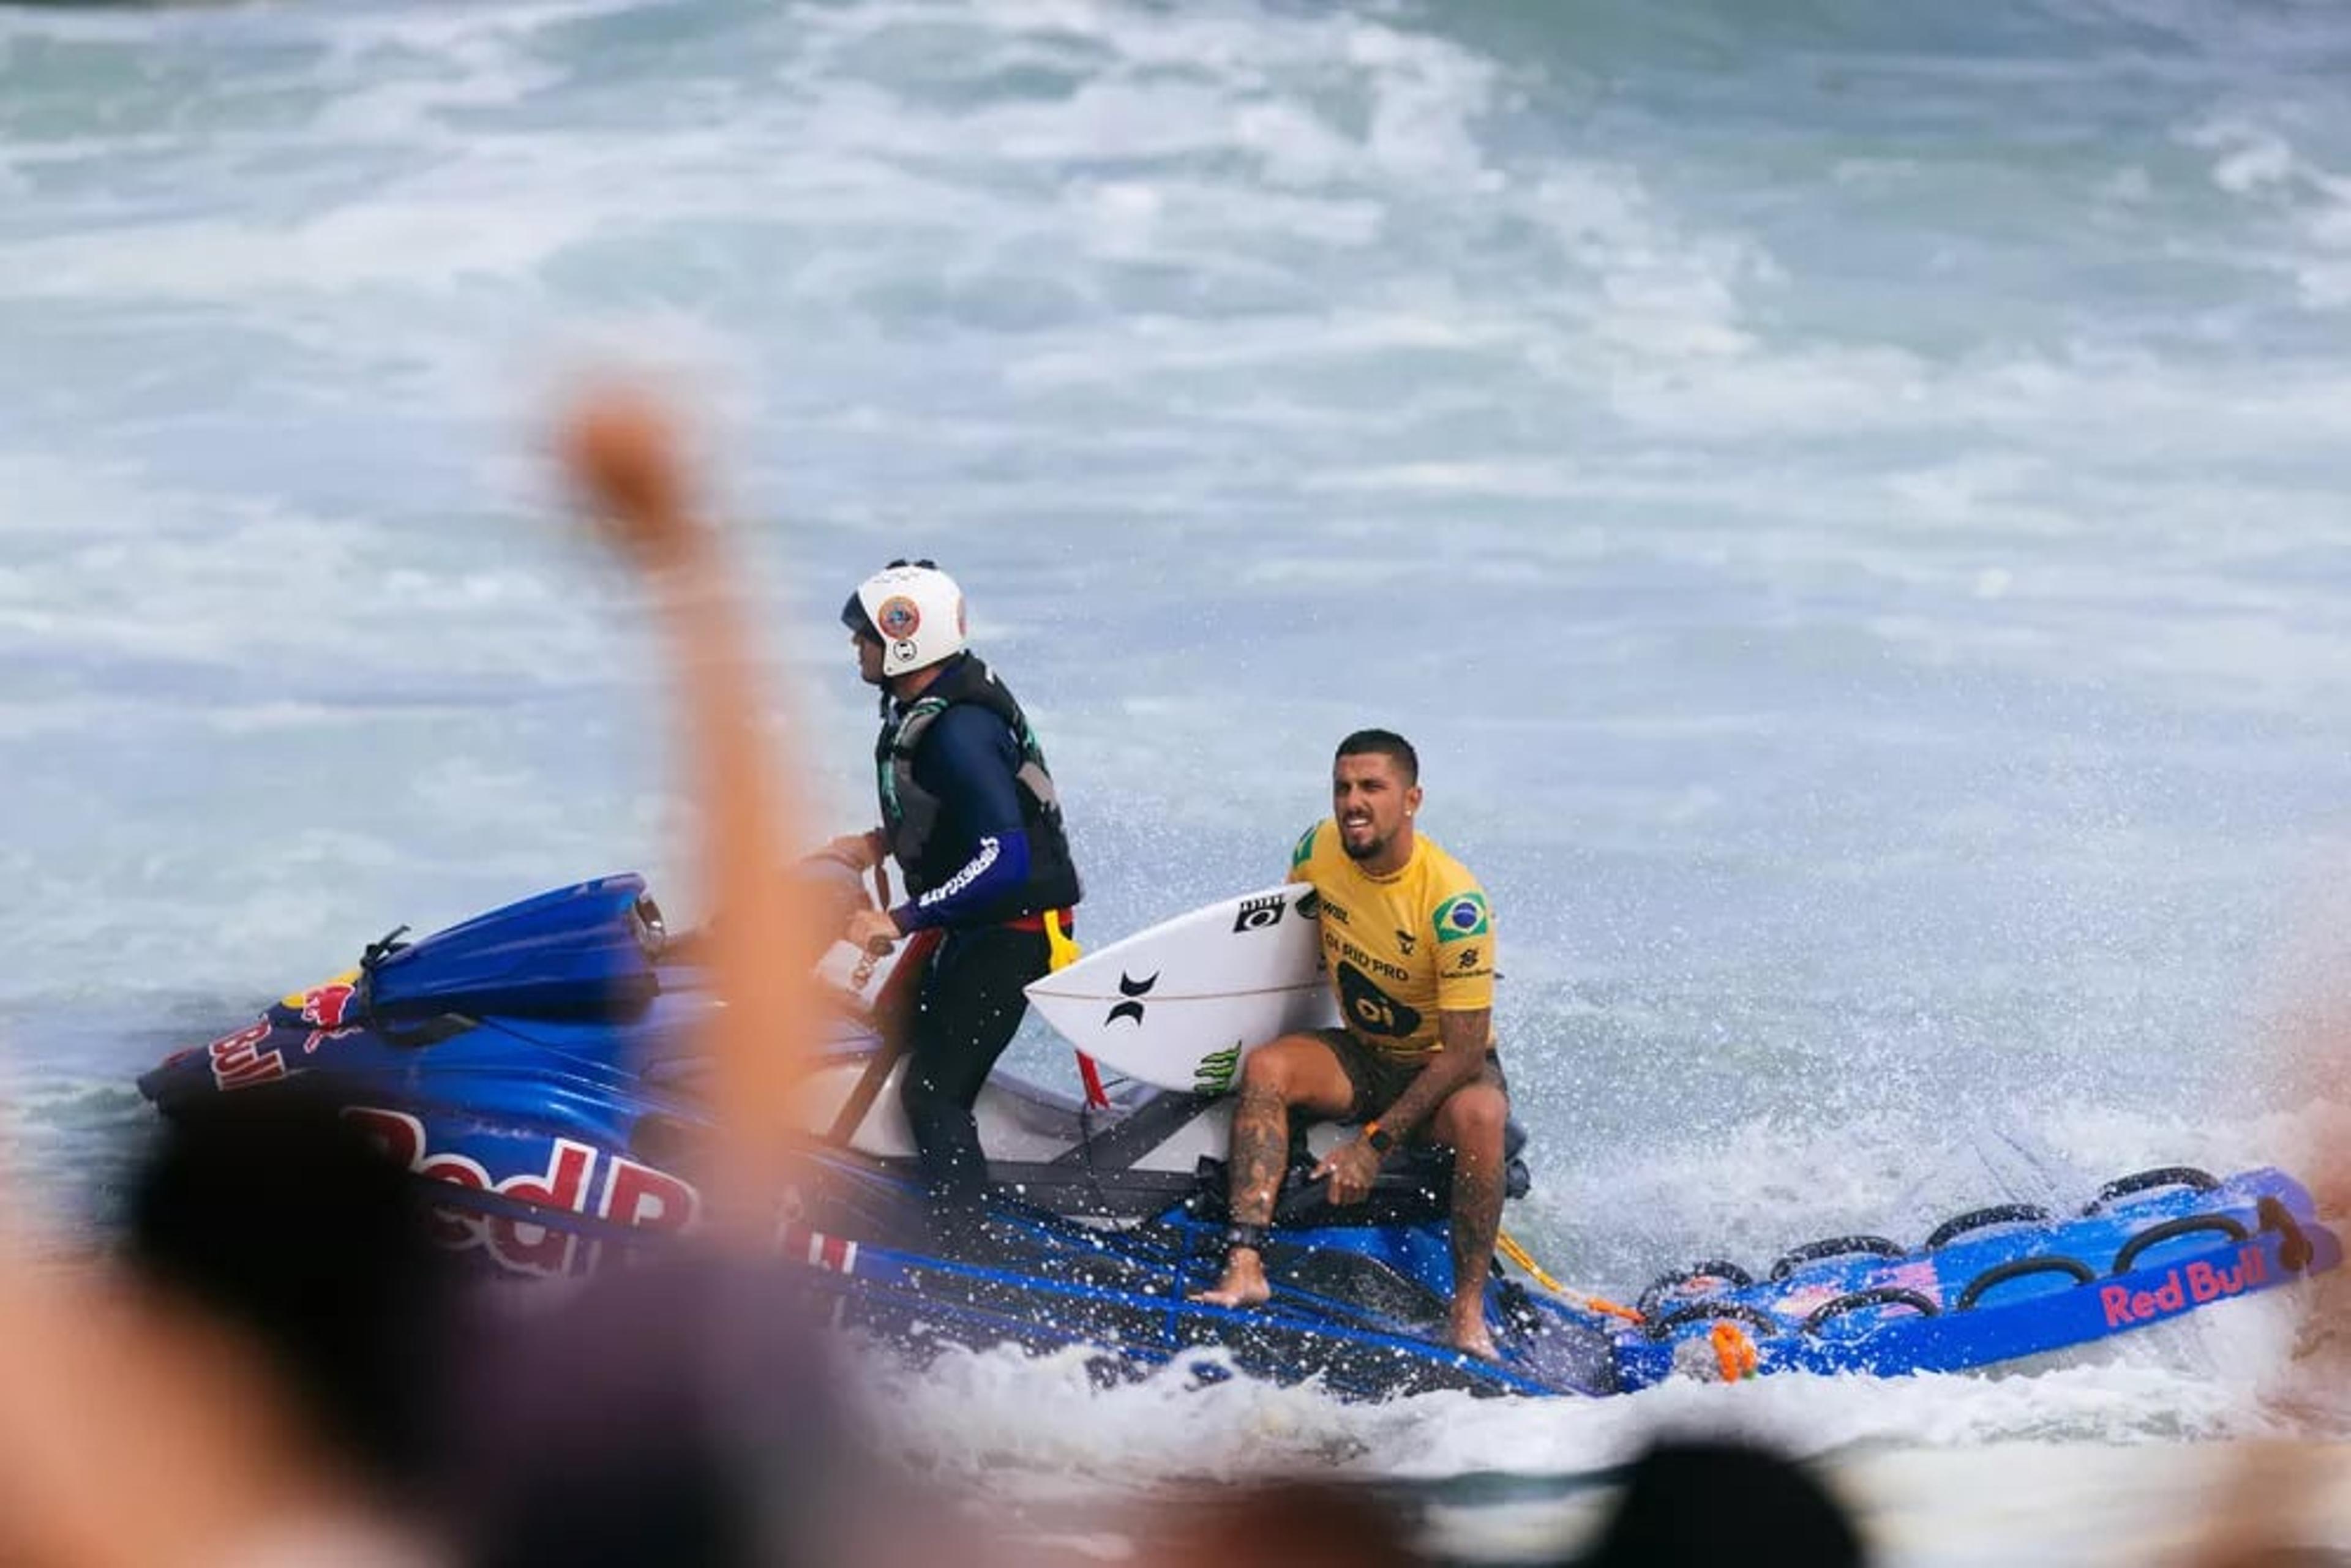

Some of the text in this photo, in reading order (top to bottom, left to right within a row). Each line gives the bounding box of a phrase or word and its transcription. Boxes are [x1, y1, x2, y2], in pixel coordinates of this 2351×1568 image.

[1372, 959, 1409, 981] PRO
[209, 1012, 286, 1092] Bull
[2101, 1247, 2267, 1327] Red Bull
